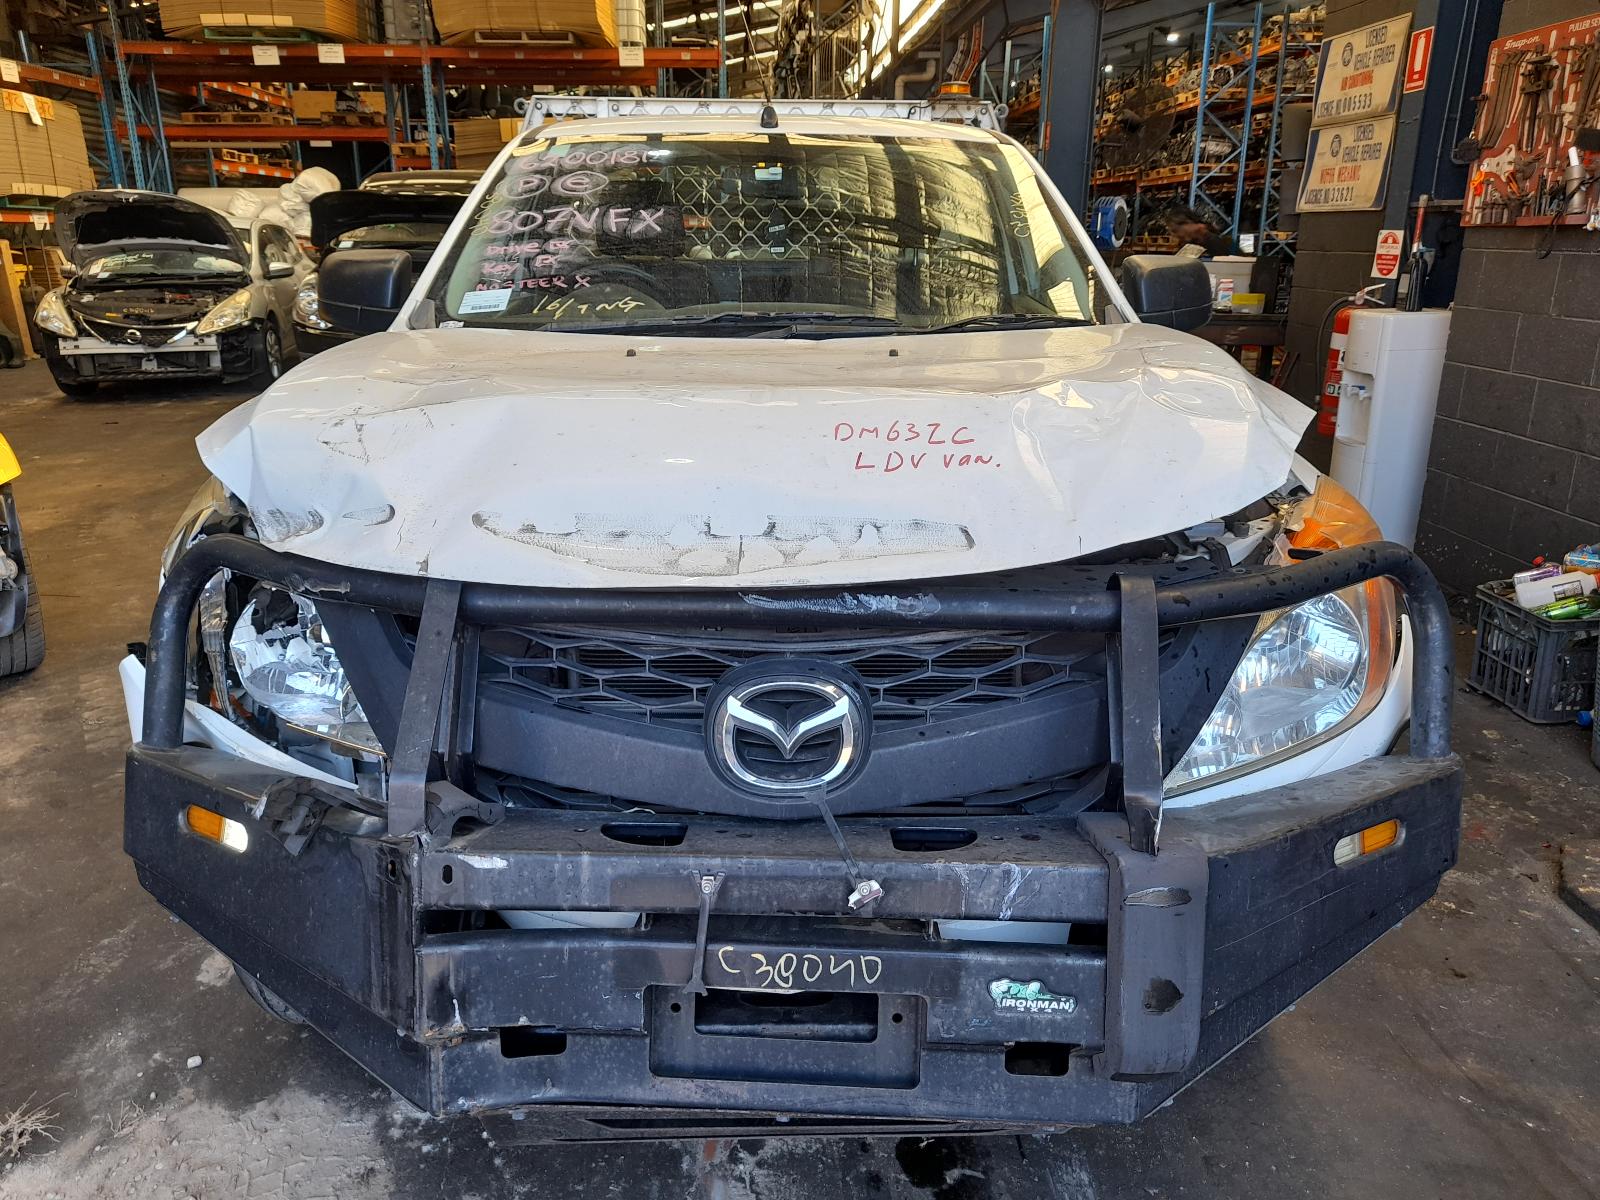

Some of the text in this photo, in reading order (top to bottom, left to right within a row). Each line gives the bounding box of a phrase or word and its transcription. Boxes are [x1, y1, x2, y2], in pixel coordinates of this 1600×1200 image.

[1568, 20, 1591, 33] PULLER
[1503, 35, 1540, 50] Snap-on
[1001, 998, 1070, 1010] IRONMAN
